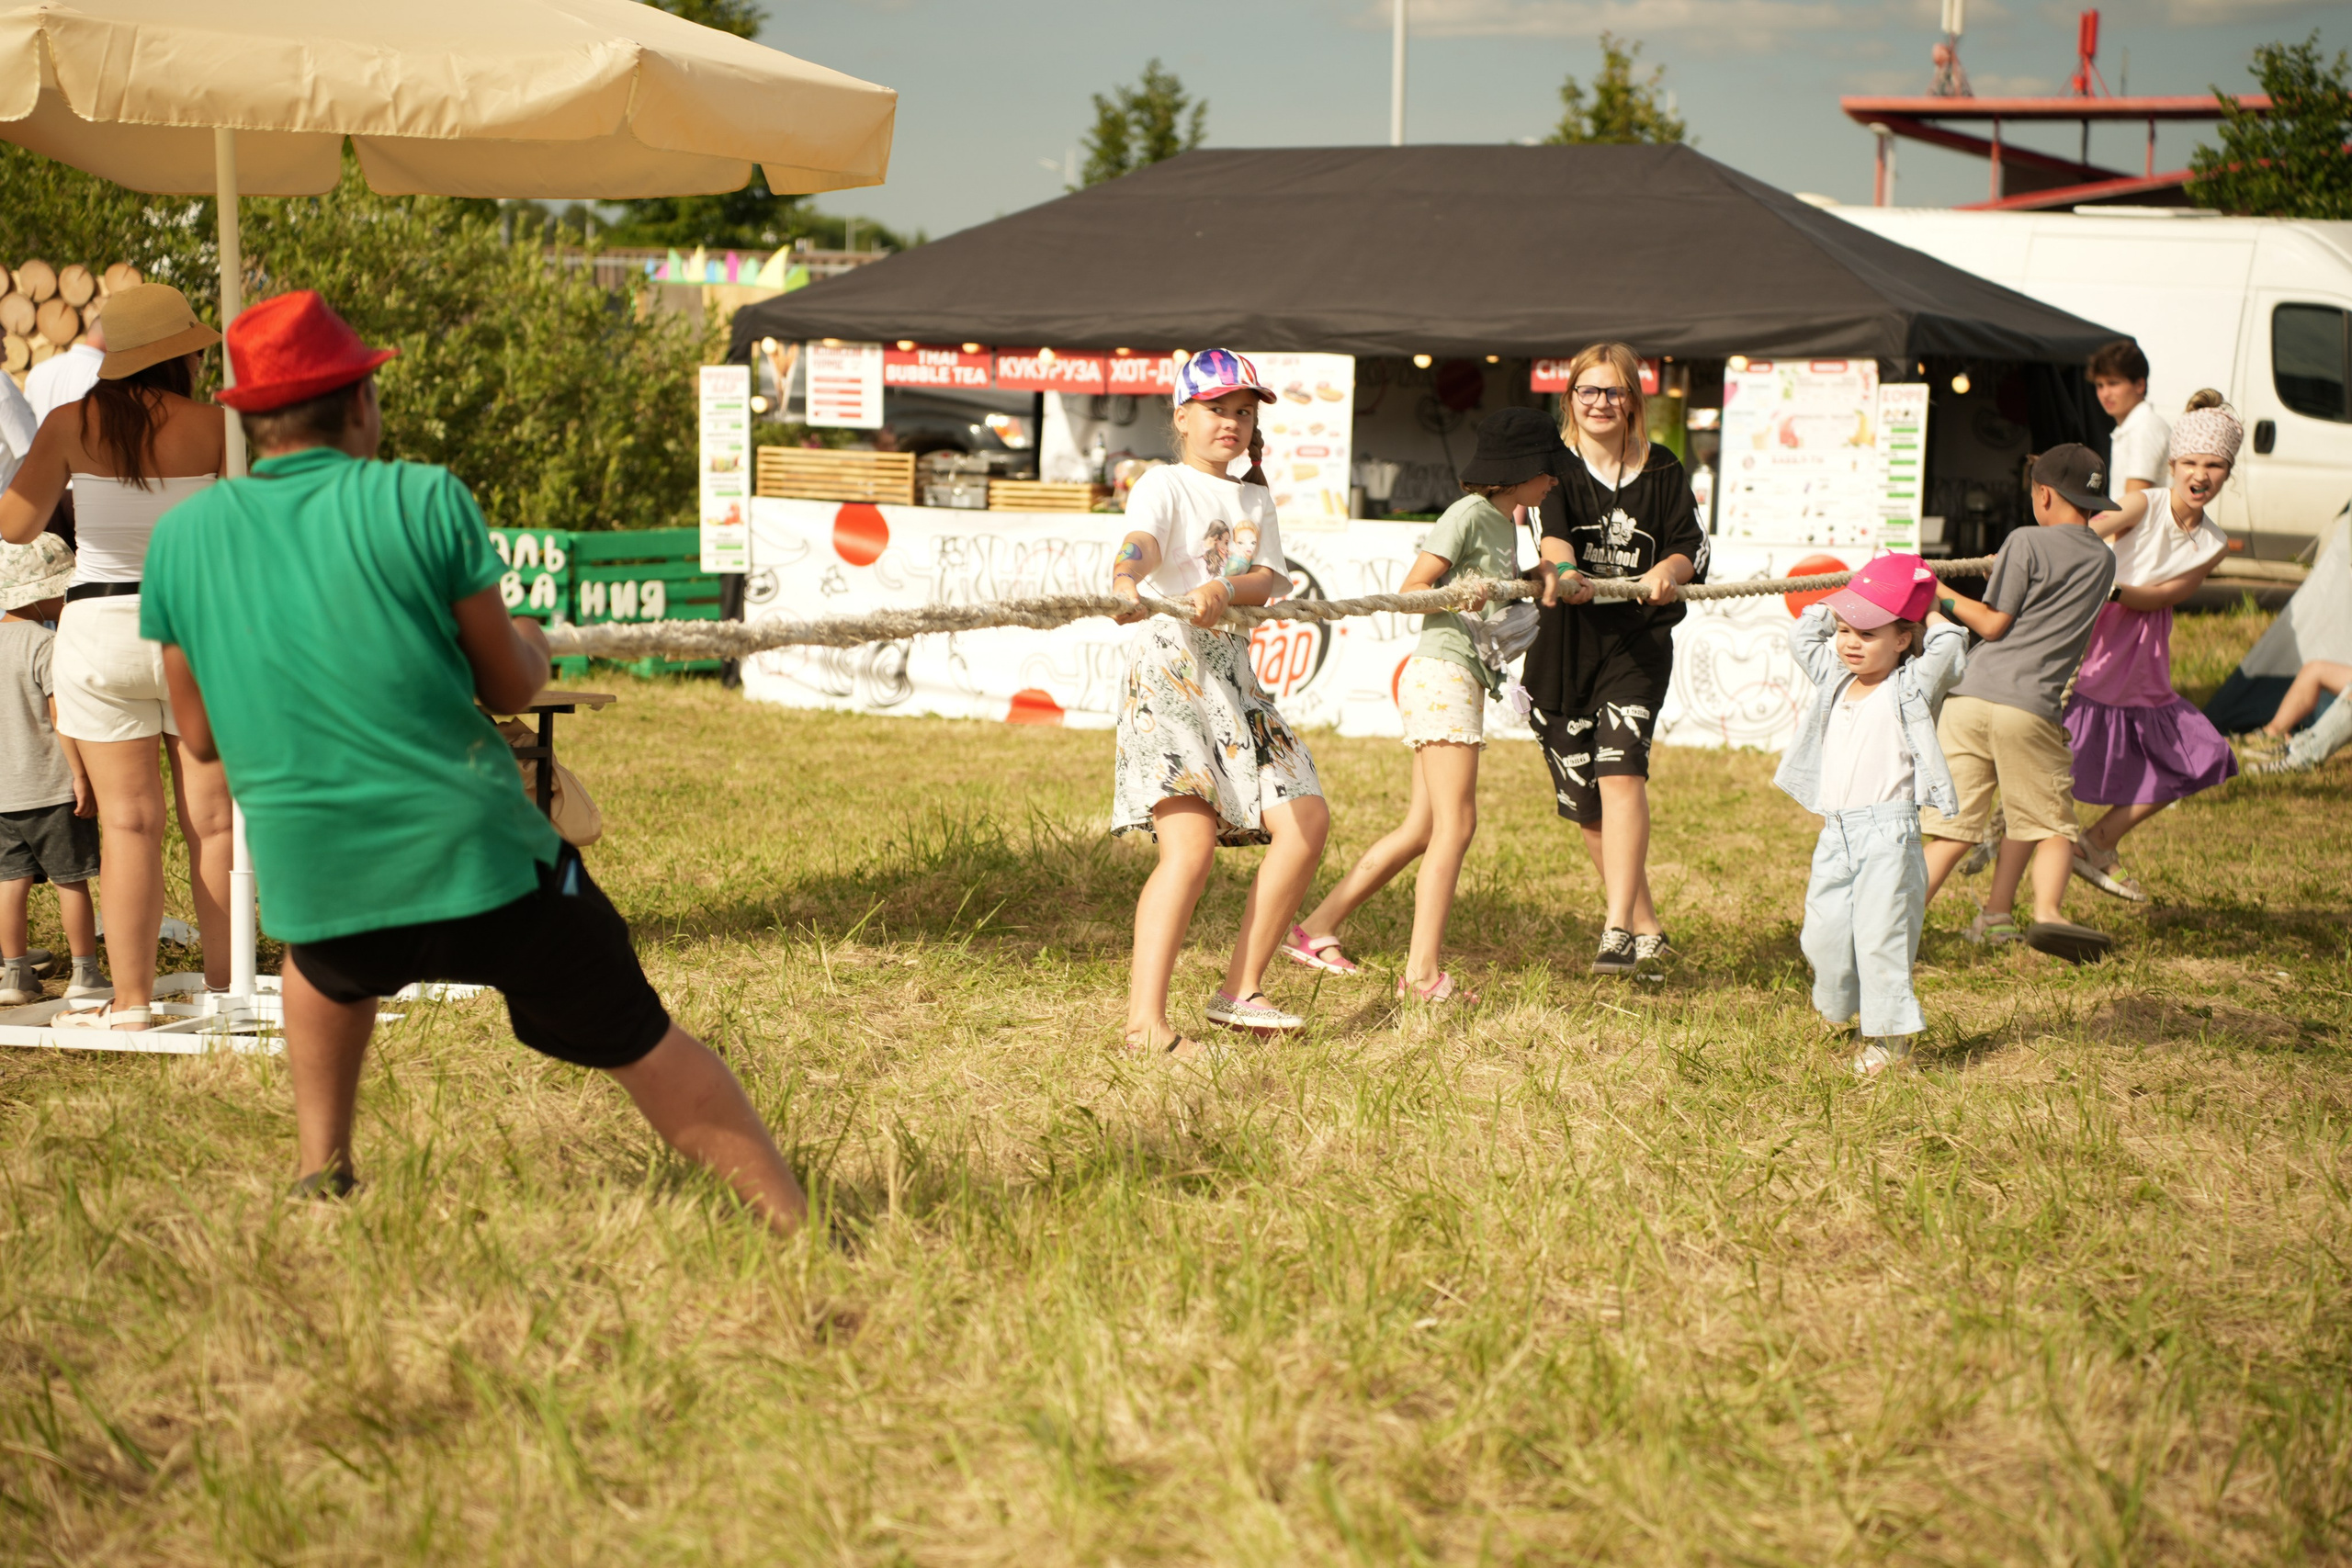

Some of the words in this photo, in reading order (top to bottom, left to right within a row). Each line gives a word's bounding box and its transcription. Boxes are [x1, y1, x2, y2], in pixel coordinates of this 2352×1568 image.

[918, 349, 958, 366] THAI
[885, 364, 950, 383] BUBBLE
[953, 367, 988, 385] TEA
[998, 356, 1102, 382] КУКУРУЗА
